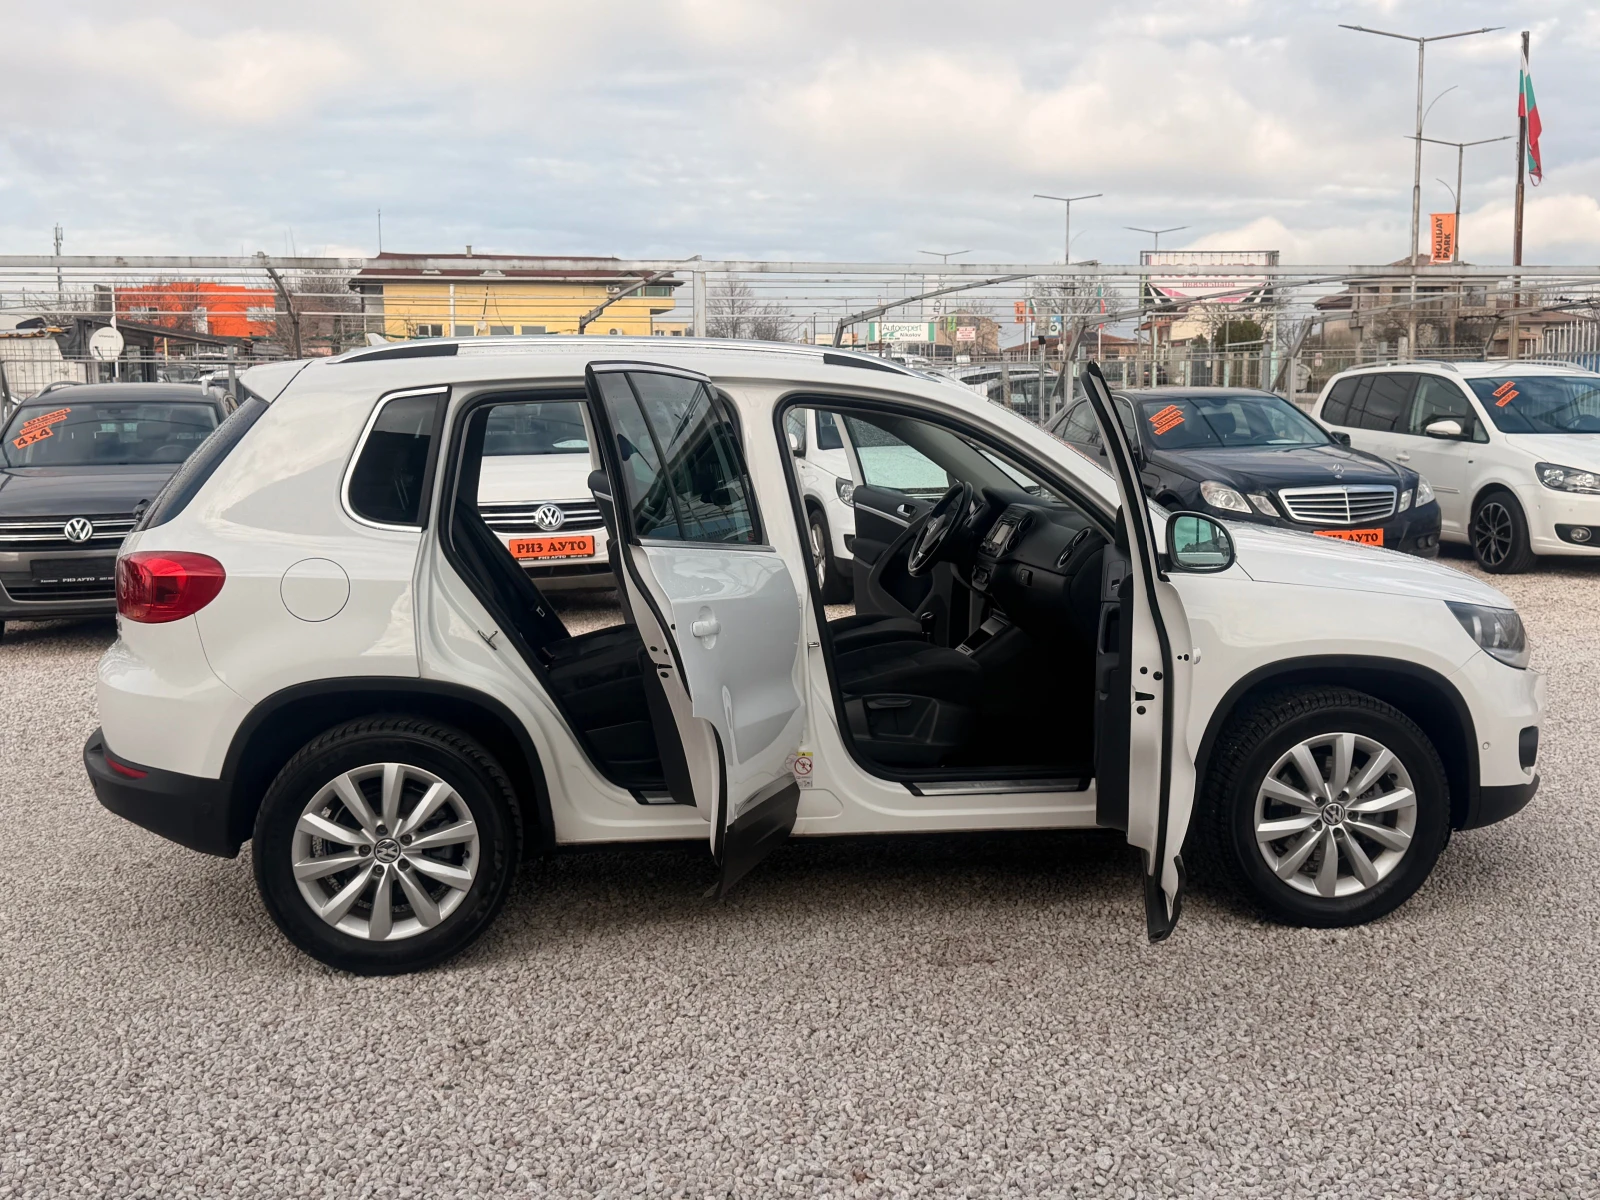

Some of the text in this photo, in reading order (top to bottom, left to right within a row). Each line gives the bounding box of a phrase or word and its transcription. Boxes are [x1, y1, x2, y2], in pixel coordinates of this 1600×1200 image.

[1435, 216, 1443, 258] HOLIDAY
[1443, 233, 1451, 258] PARK
[882, 323, 922, 332] Autoexpert
[1347, 532, 1379, 543] АУТО
[517, 540, 587, 554] РИЗ АУТО
